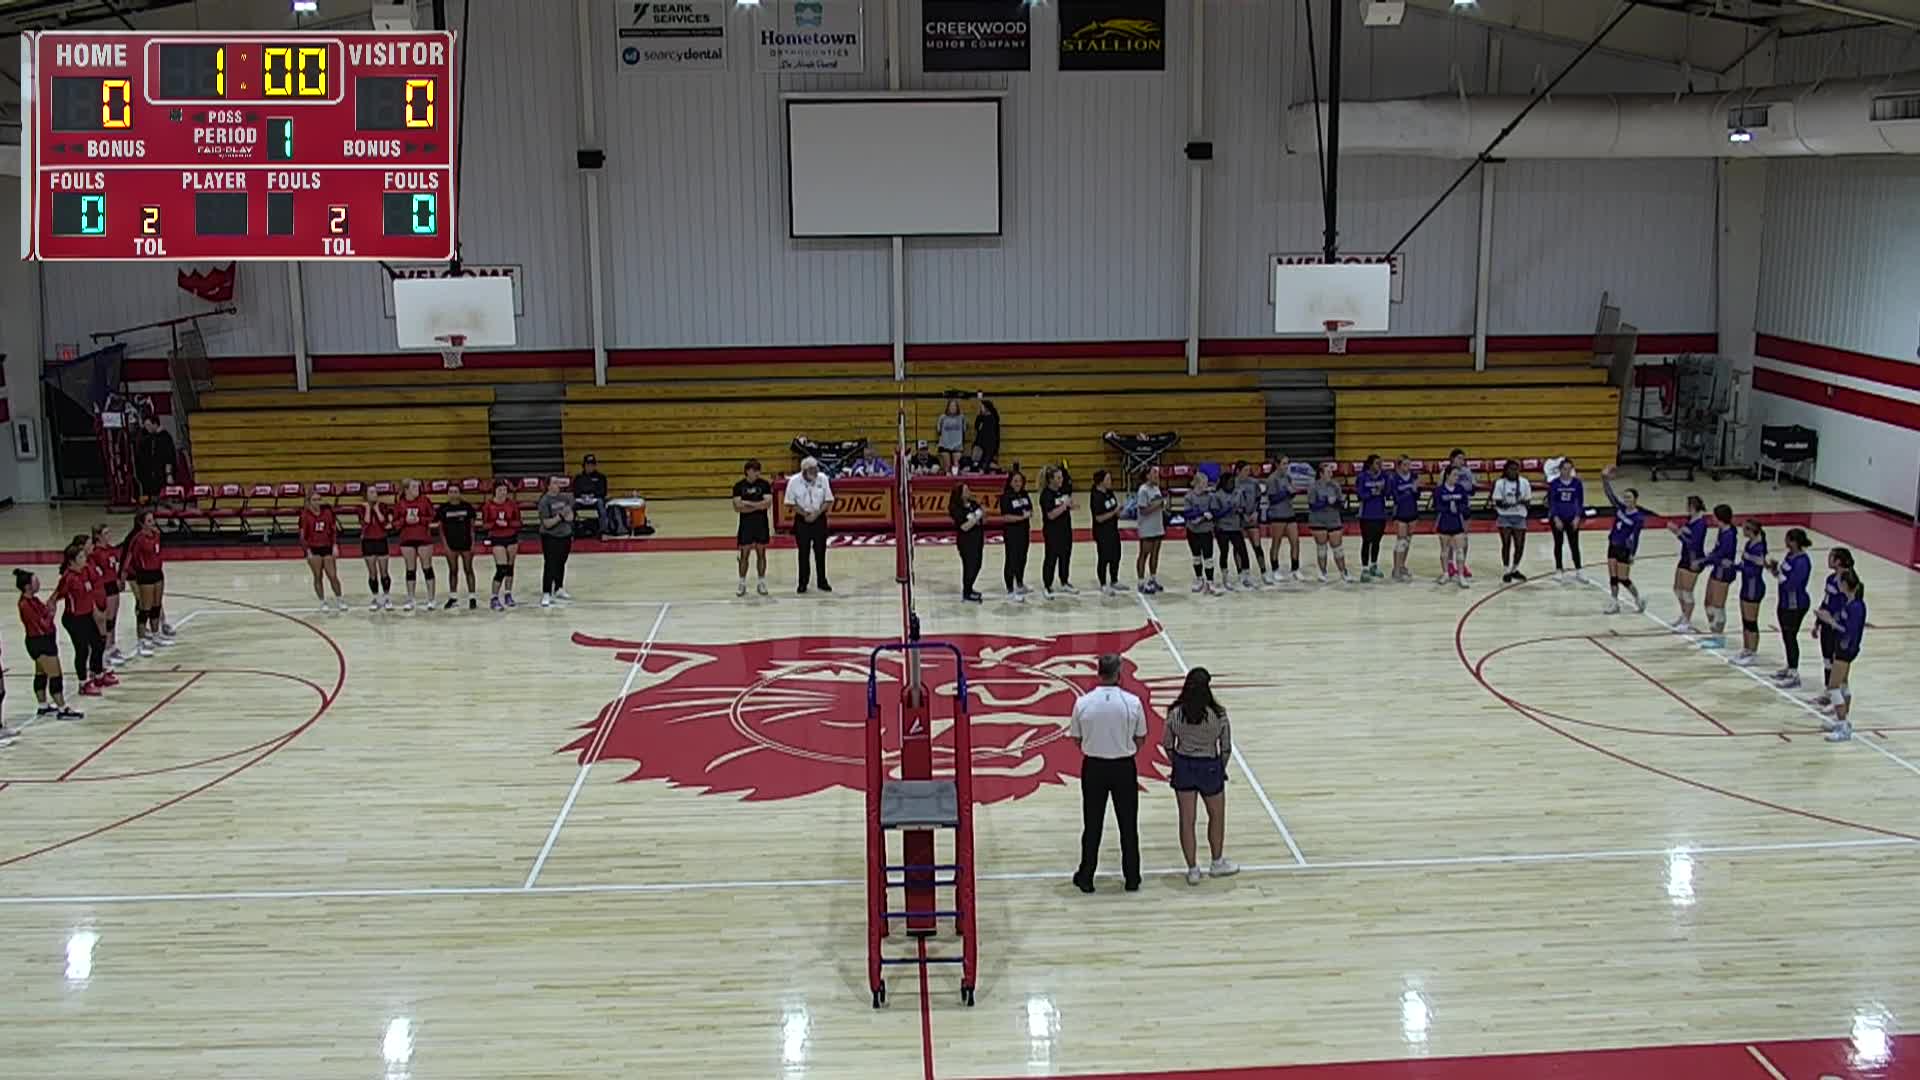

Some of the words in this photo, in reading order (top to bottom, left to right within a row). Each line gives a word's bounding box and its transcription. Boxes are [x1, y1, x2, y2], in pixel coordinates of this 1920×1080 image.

[653, 14, 710, 24] SERVICES
[926, 21, 1027, 38] CREEKWOOD
[761, 30, 857, 46] Hometown
[926, 40, 966, 49] MOTOR
[971, 40, 1027, 48] COMPANY
[1063, 39, 1161, 51] STALLION
